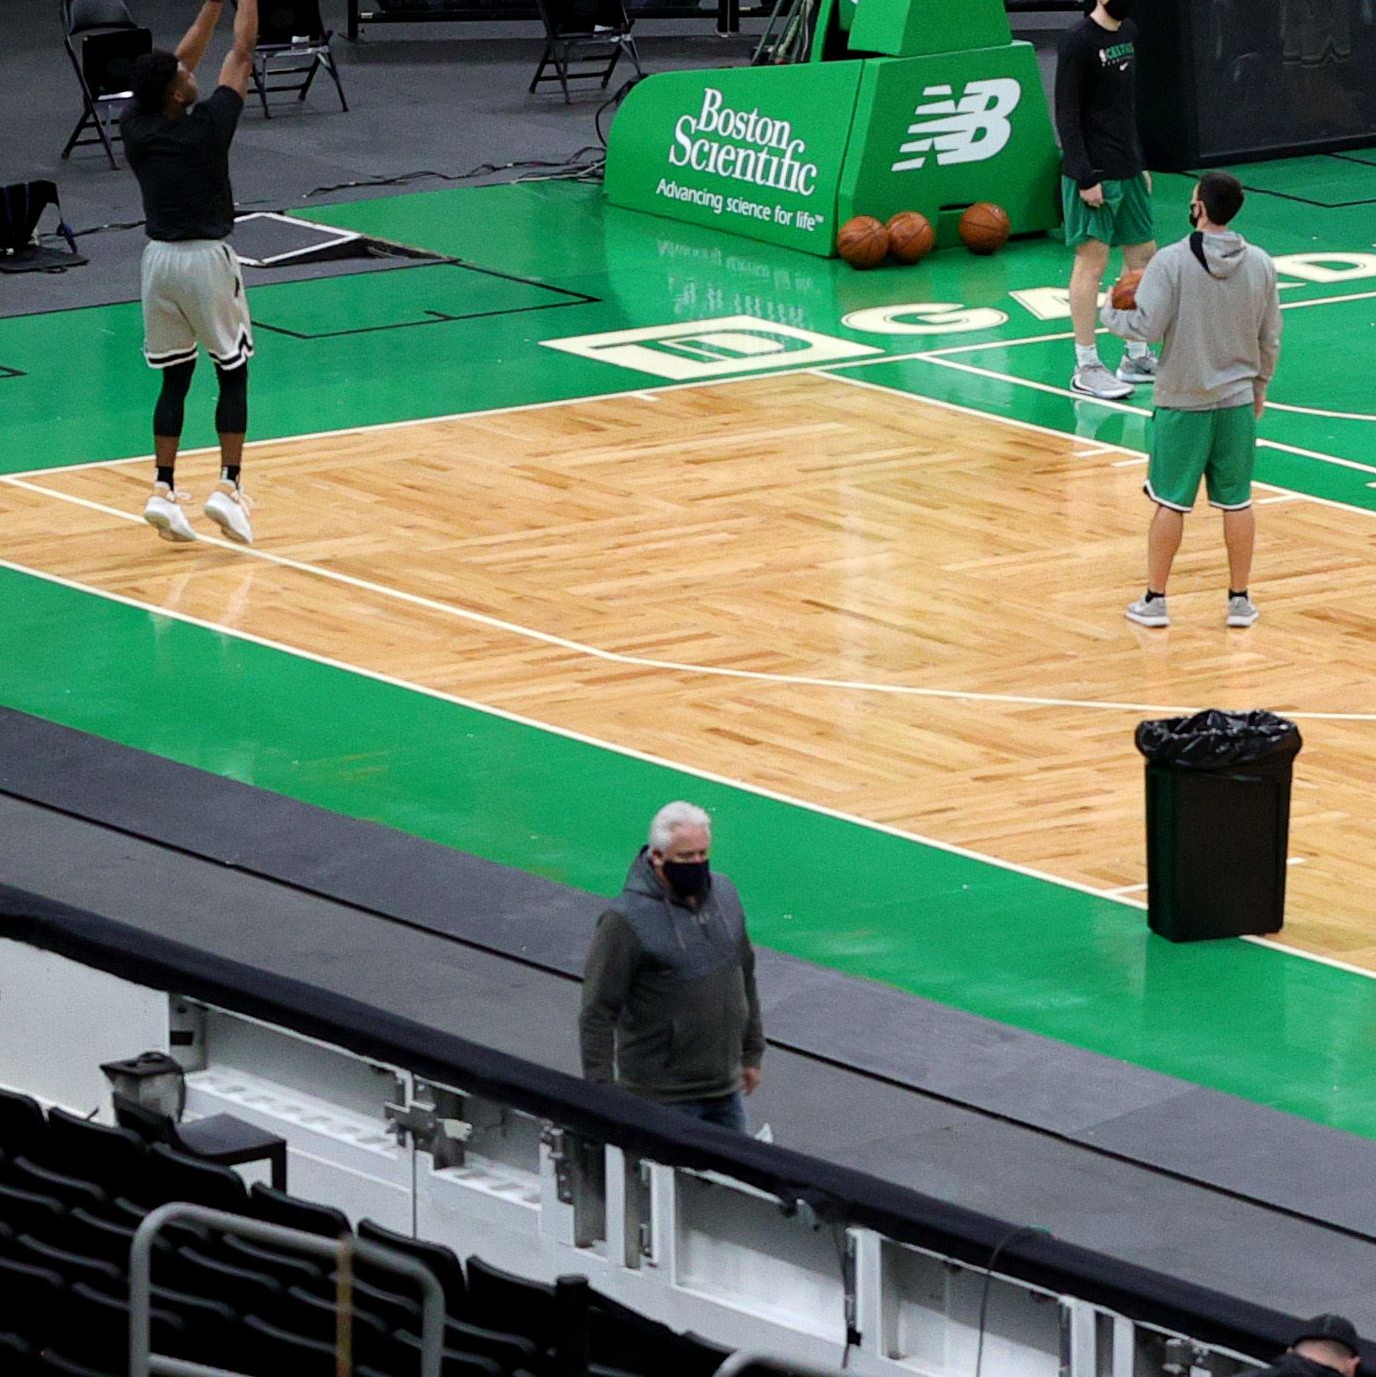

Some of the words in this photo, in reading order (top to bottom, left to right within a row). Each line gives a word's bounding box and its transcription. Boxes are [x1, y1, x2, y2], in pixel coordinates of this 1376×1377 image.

[700, 88, 791, 149] Boston
[892, 77, 1022, 173] NB
[669, 114, 818, 197] Scientific
[656, 178, 724, 213] Advancing
[726, 197, 771, 222] science
[774, 205, 794, 228] for
